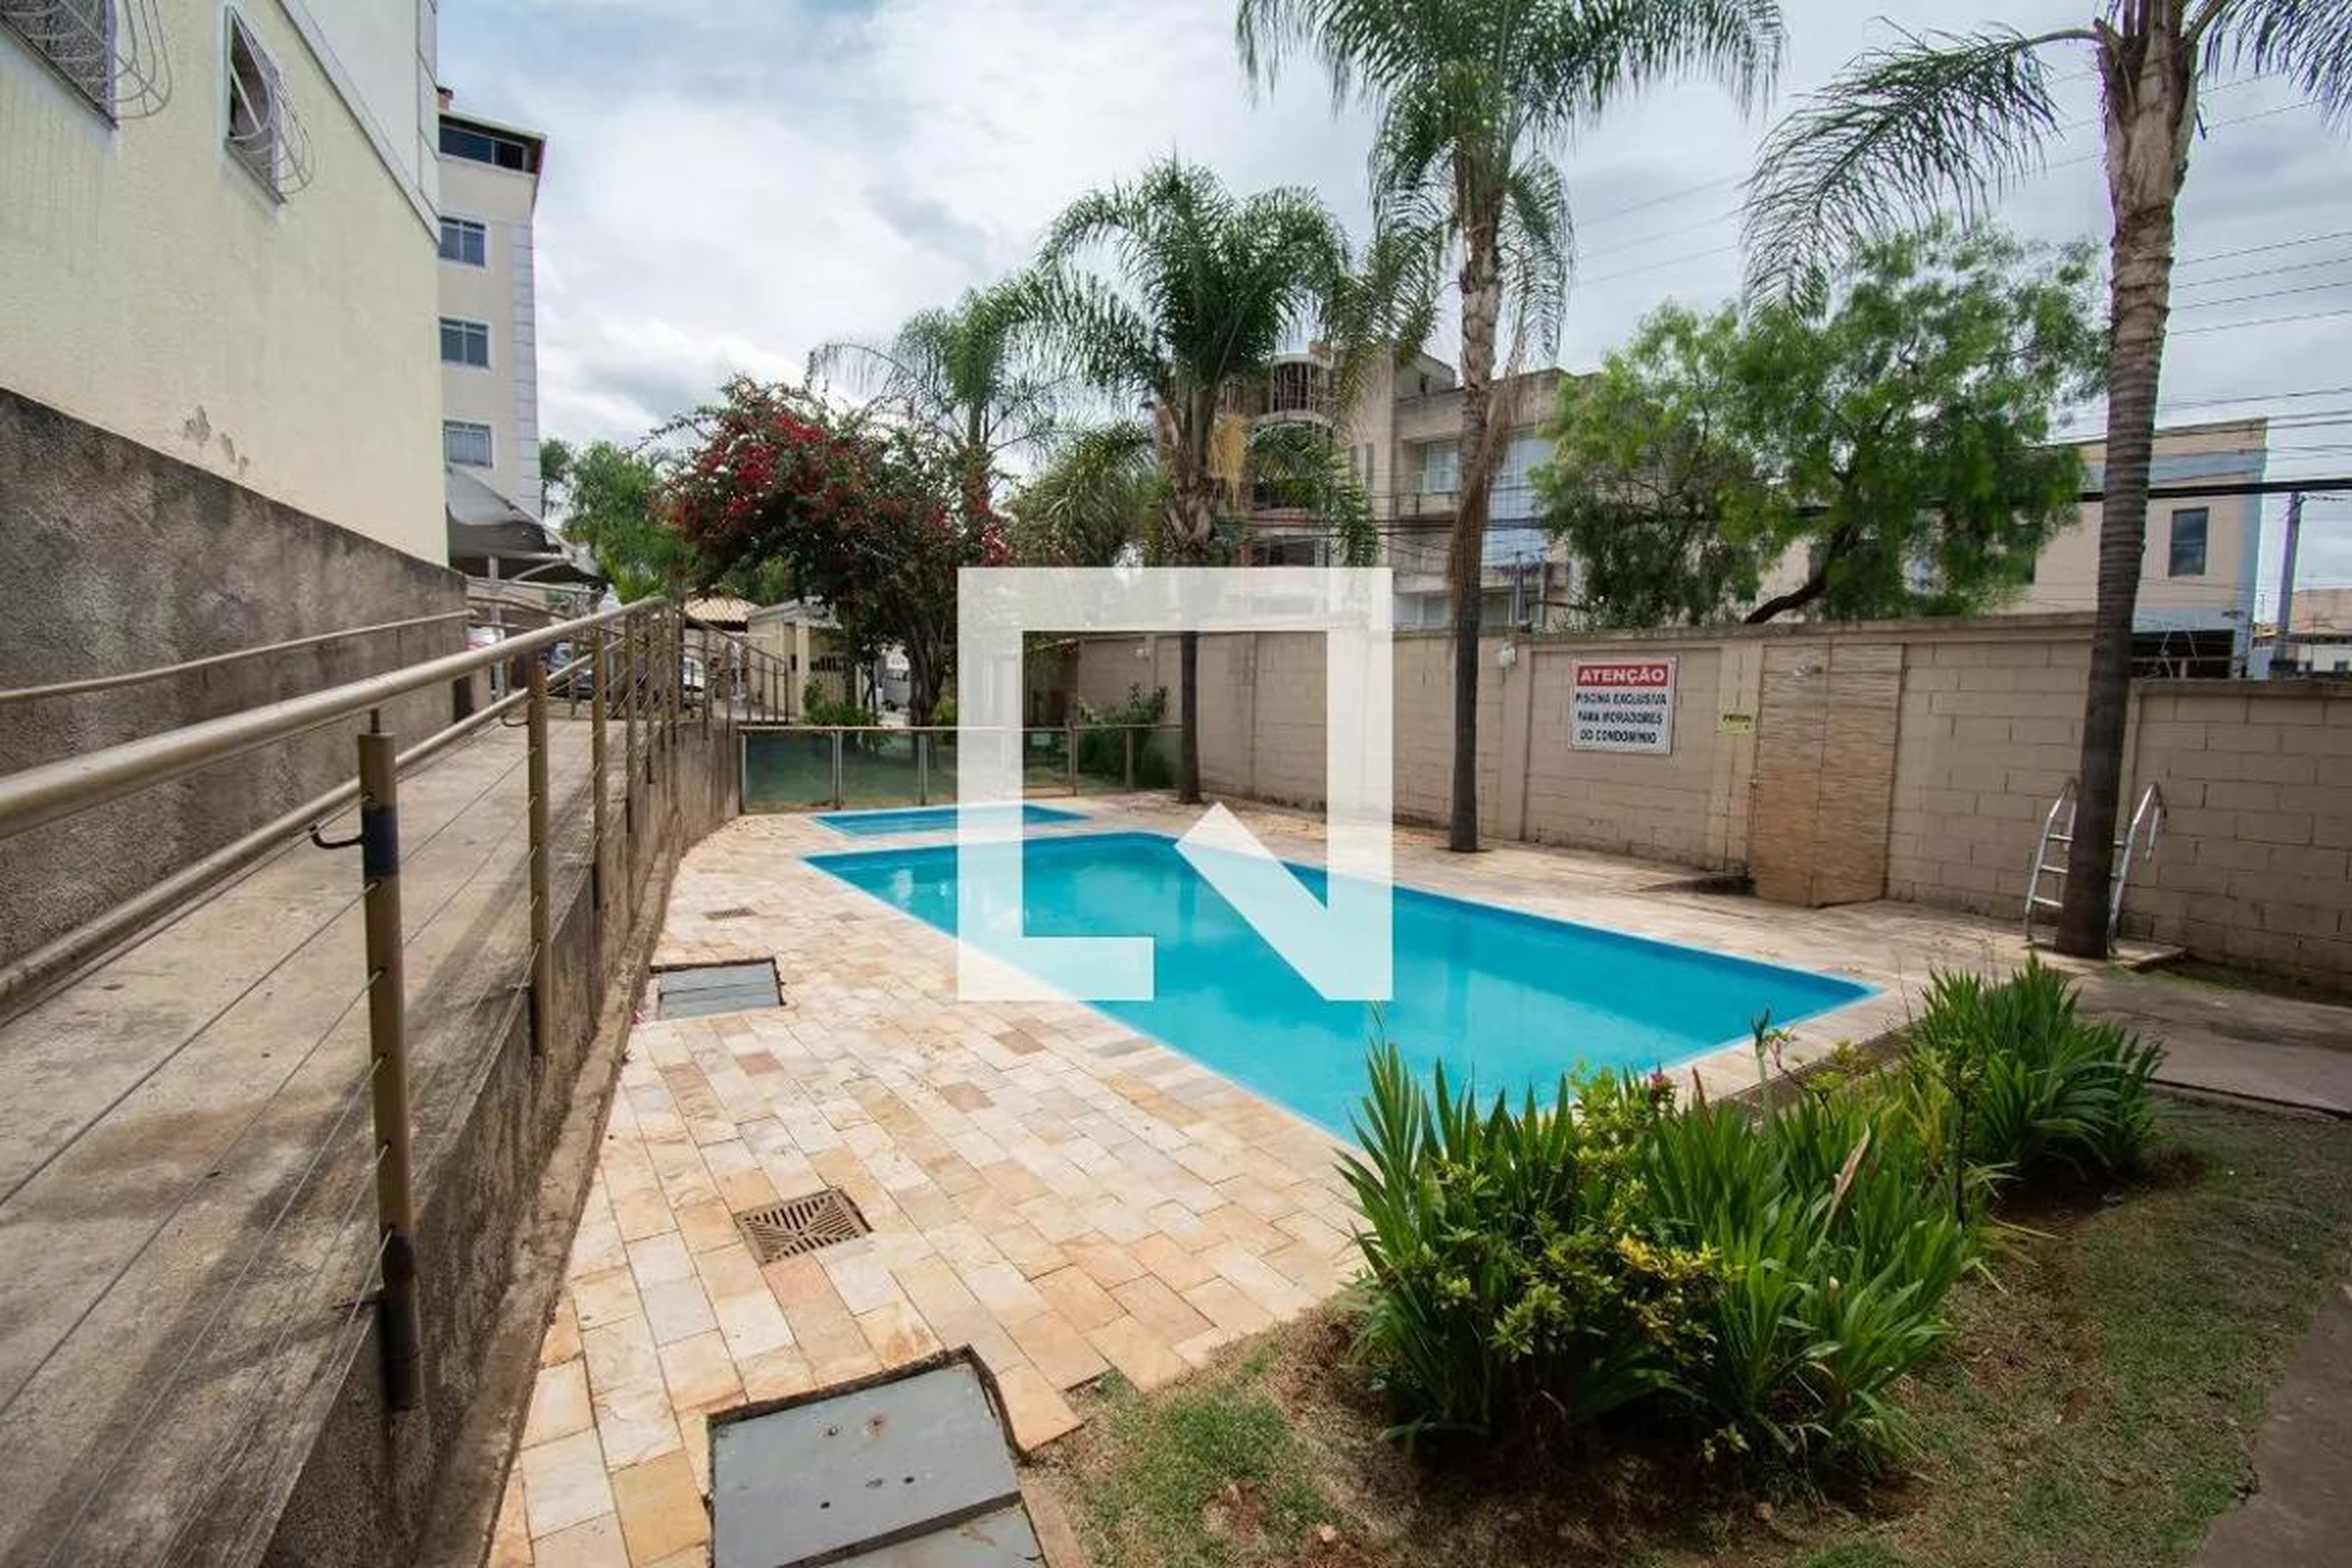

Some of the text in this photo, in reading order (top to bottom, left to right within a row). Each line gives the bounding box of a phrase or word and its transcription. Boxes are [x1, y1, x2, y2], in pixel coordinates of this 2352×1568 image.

[1580, 666, 1665, 684] ATENÇÃO
[1576, 693, 1667, 705] PISCINA EXCLUSIVA
[1578, 710, 1662, 725] PARA MORADORES
[1580, 728, 1593, 740] DO
